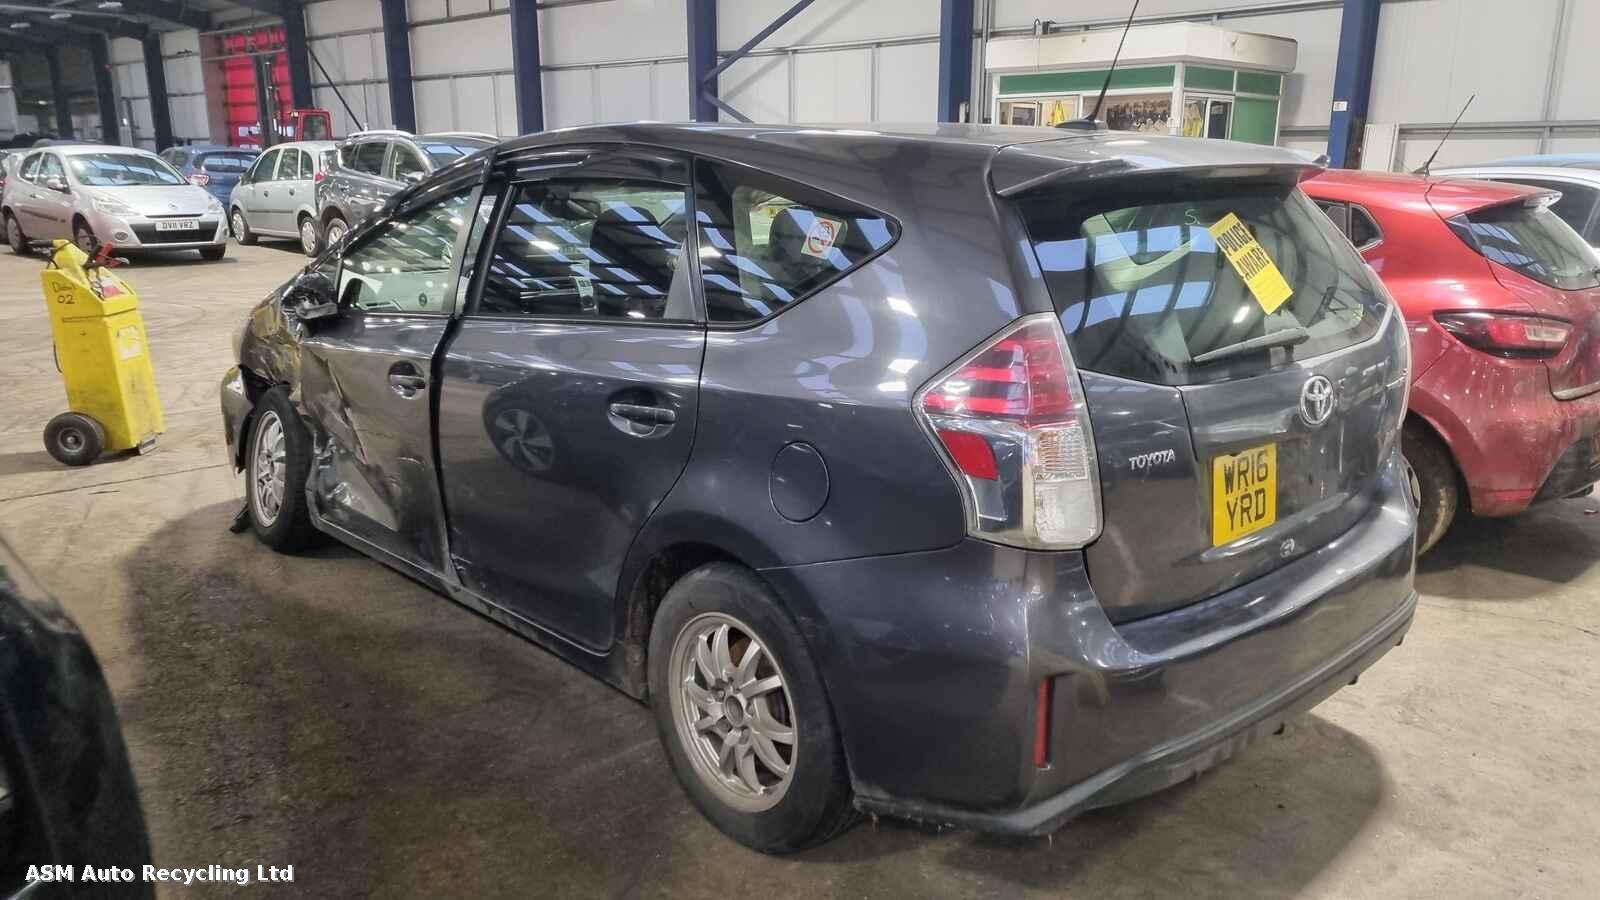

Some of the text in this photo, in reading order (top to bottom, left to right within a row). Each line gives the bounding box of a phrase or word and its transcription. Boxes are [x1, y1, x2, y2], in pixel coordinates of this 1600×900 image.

[1216, 223, 1254, 257] POLICE
[1236, 247, 1270, 281] AWARE
[1129, 449, 1176, 470] TOYOTA
[1224, 450, 1269, 495] WR16
[1226, 488, 1266, 531] YRD
